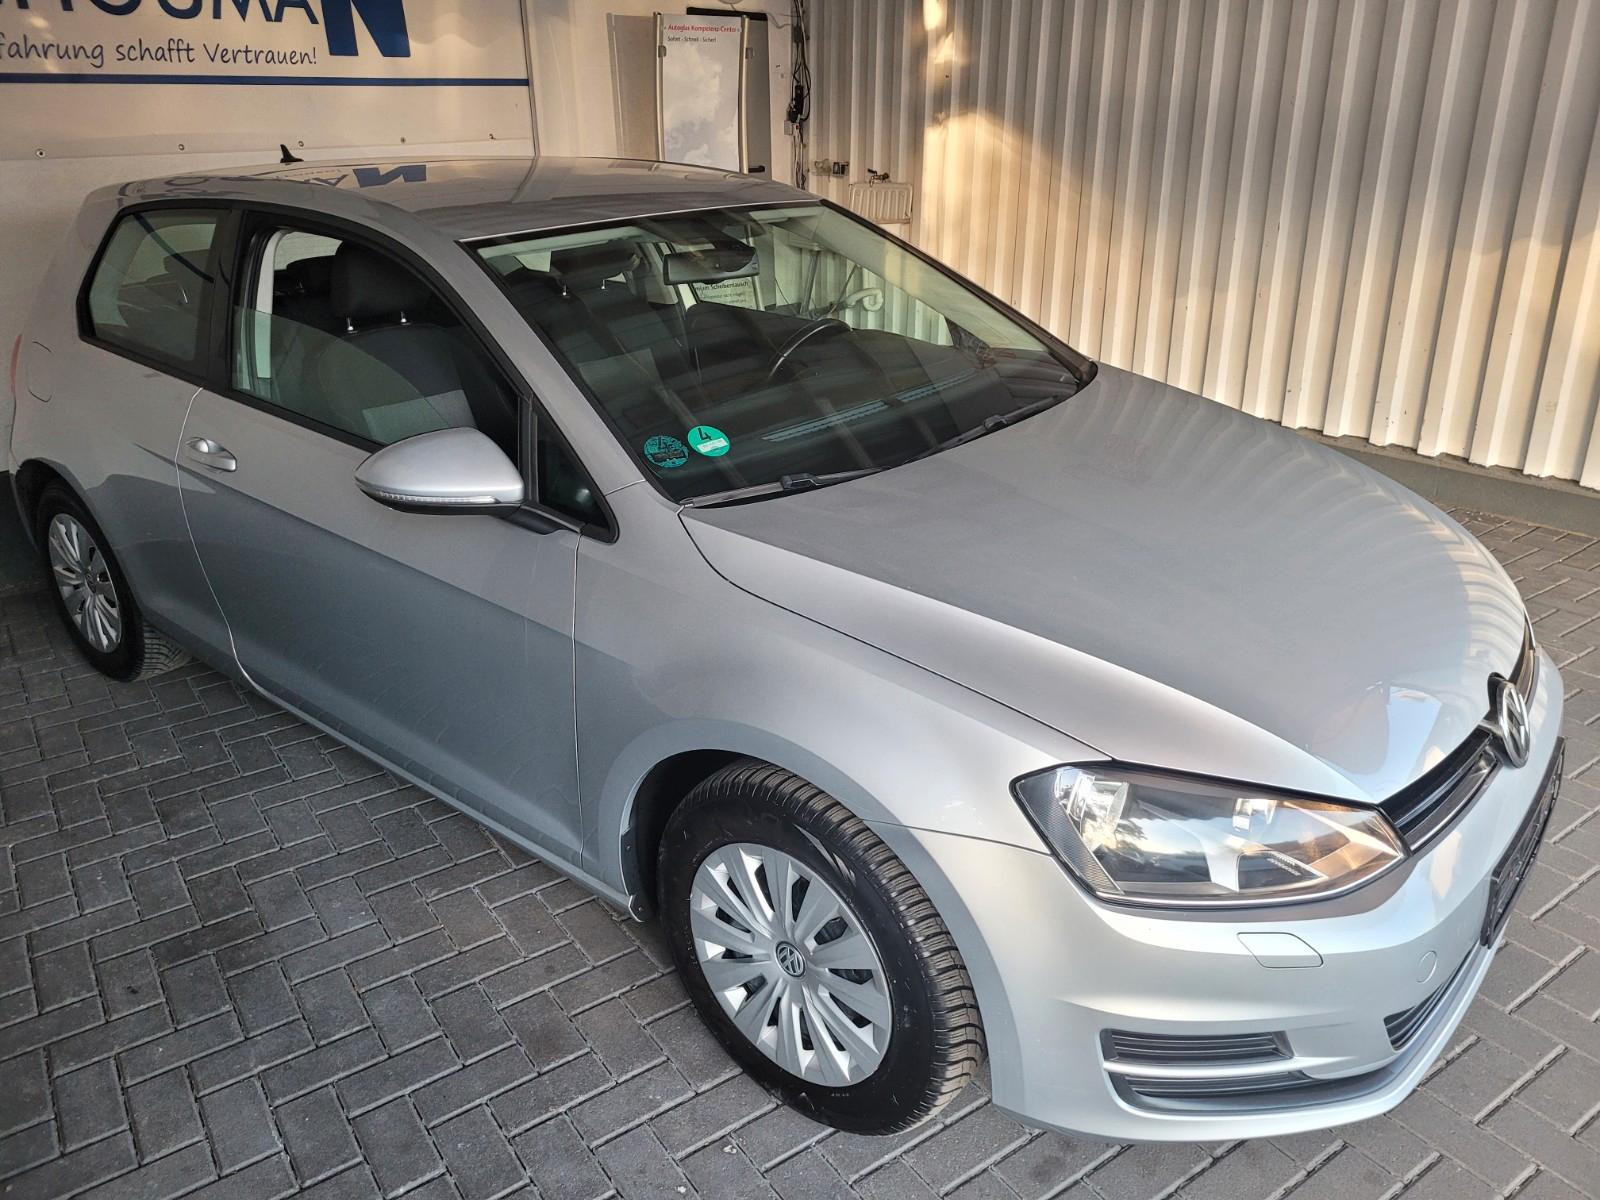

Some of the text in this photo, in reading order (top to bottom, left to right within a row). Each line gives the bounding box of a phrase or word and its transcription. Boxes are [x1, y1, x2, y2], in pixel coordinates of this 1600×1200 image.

[115, 38, 196, 64] schafft
[203, 43, 318, 65] Vertrauen!
[697, 427, 712, 440] 4
